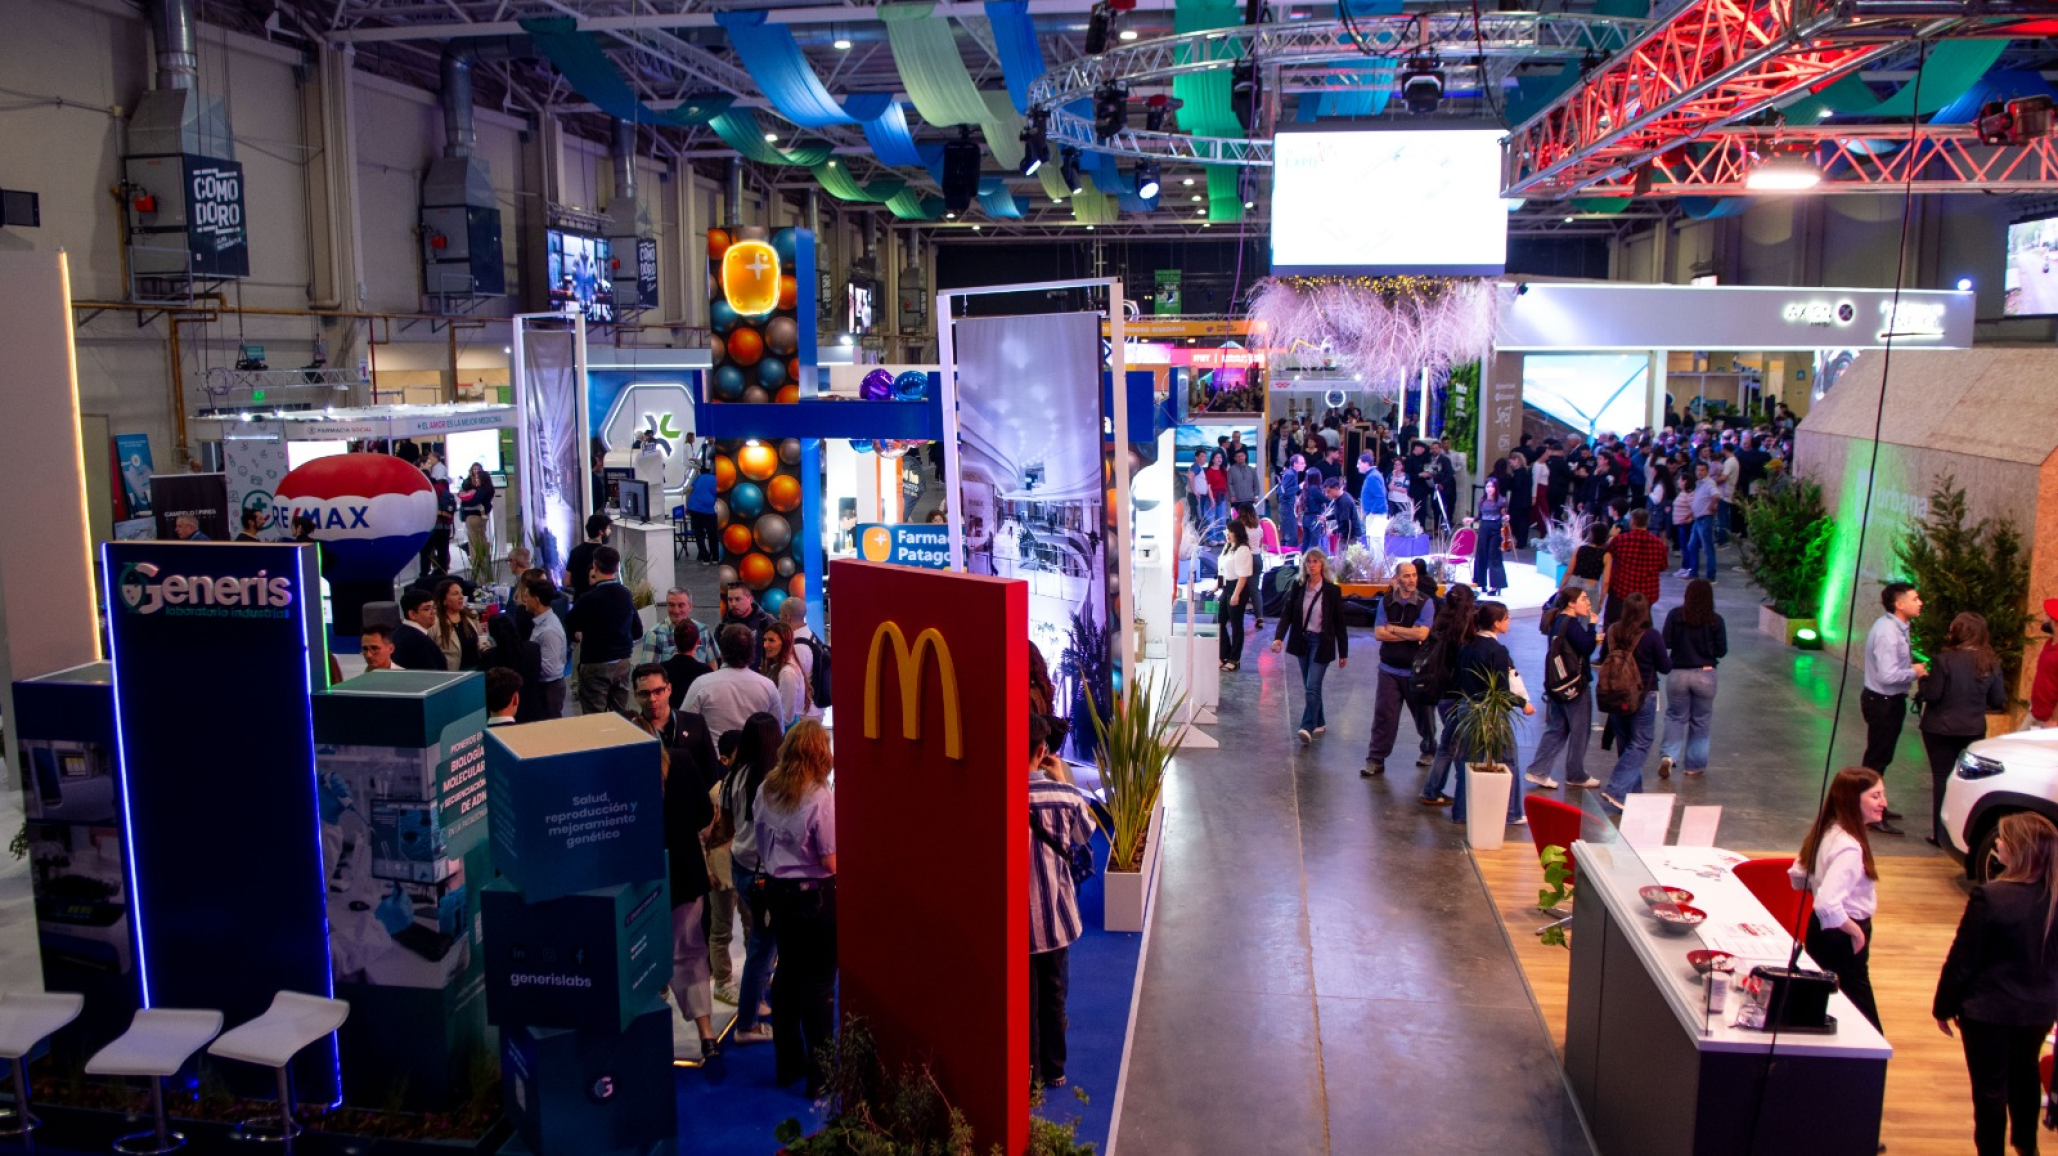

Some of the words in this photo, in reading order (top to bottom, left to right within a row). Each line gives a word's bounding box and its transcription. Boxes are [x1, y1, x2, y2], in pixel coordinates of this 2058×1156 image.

[193, 176, 239, 203] COMO
[195, 201, 241, 228] DORO
[421, 421, 429, 431] EL
[429, 419, 446, 429] AMOR
[447, 418, 454, 428] ES
[454, 418, 460, 427] LA
[460, 417, 478, 427] MEJOR
[478, 415, 503, 426] MEDICINA
[118, 561, 293, 615] Generis
[165, 606, 229, 617] laboratorio
[231, 607, 290, 619] industrial
[451, 743, 485, 773] BIOLOGÍA
[442, 760, 486, 793] MOLECULAR
[461, 799, 473, 815] DE
[572, 791, 611, 806] Salud,
[544, 801, 628, 824] reproducción
[630, 800, 638, 812] y
[548, 814, 636, 837] mejoramiento
[566, 828, 621, 849] genético
[509, 972, 593, 988] generislabs
